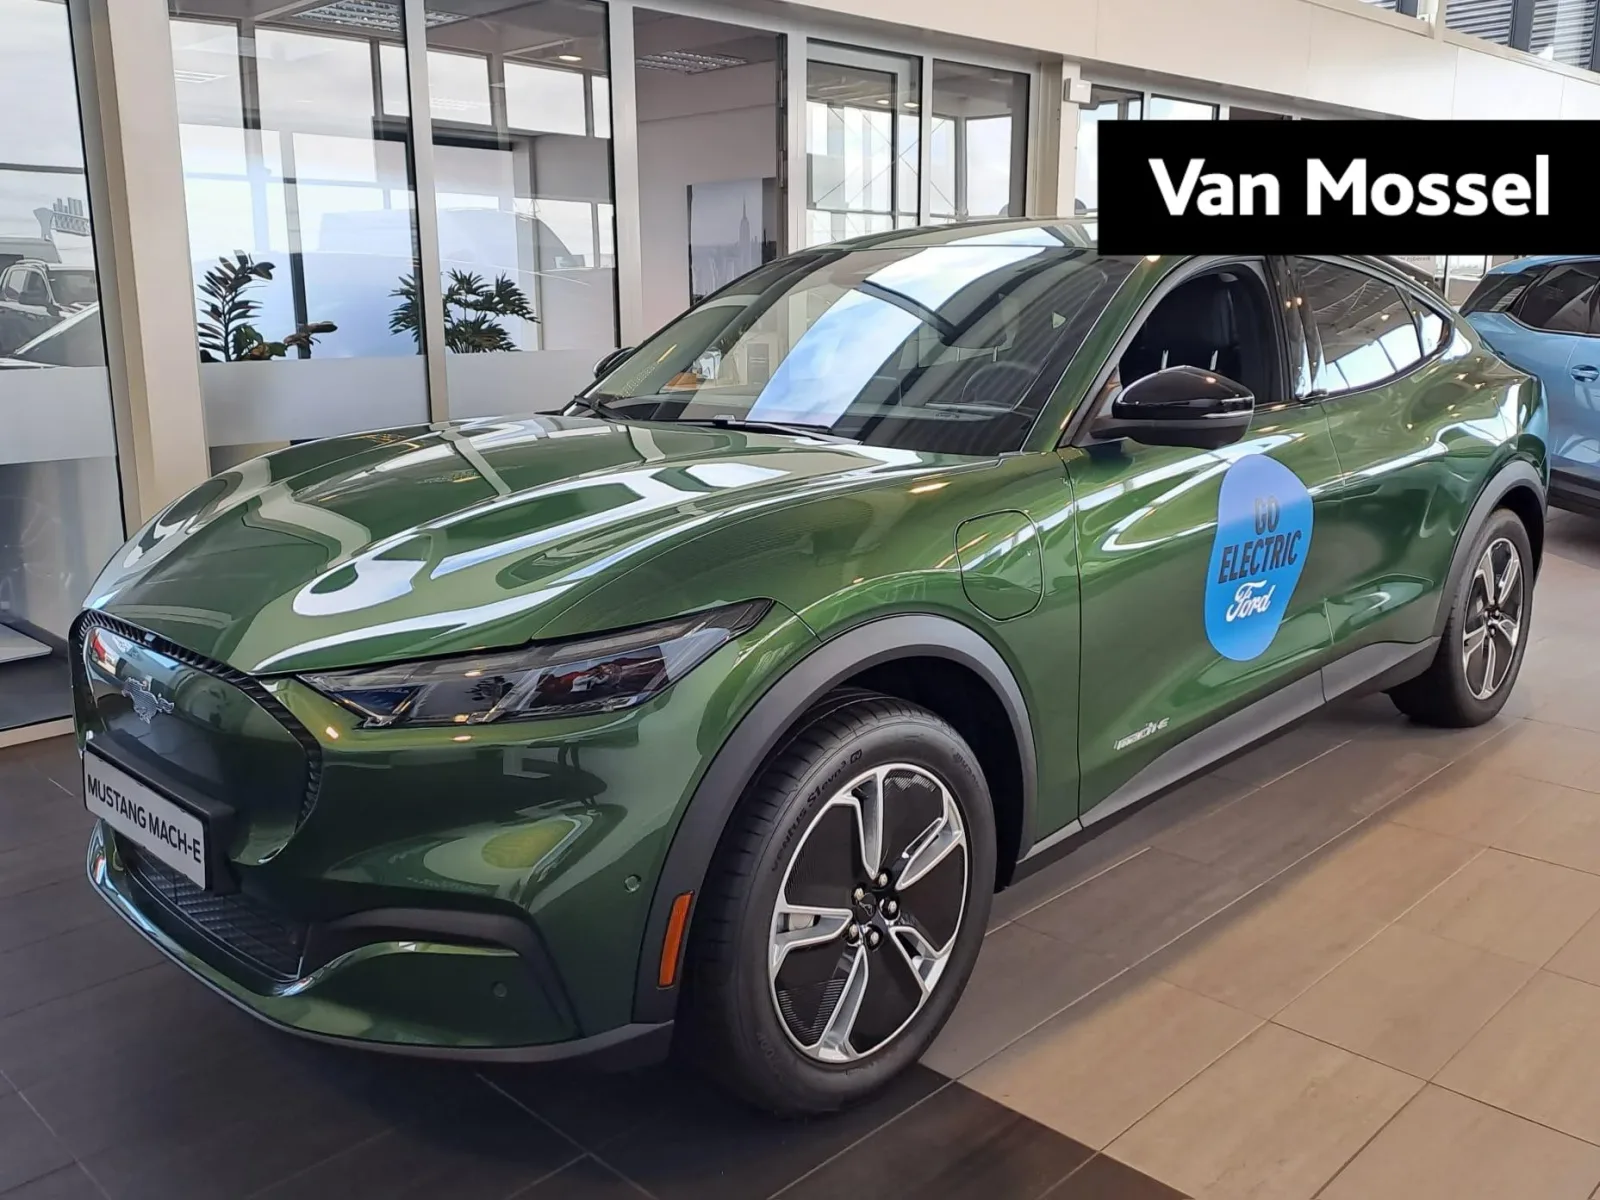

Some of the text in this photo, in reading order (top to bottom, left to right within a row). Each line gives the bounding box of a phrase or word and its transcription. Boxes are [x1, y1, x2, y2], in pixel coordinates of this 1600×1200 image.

[1254, 497, 1280, 535] GO
[1218, 530, 1302, 584] ELECTRIC
[1226, 580, 1276, 622] Ford
[88, 774, 201, 864] MUSTANG MACH-E
